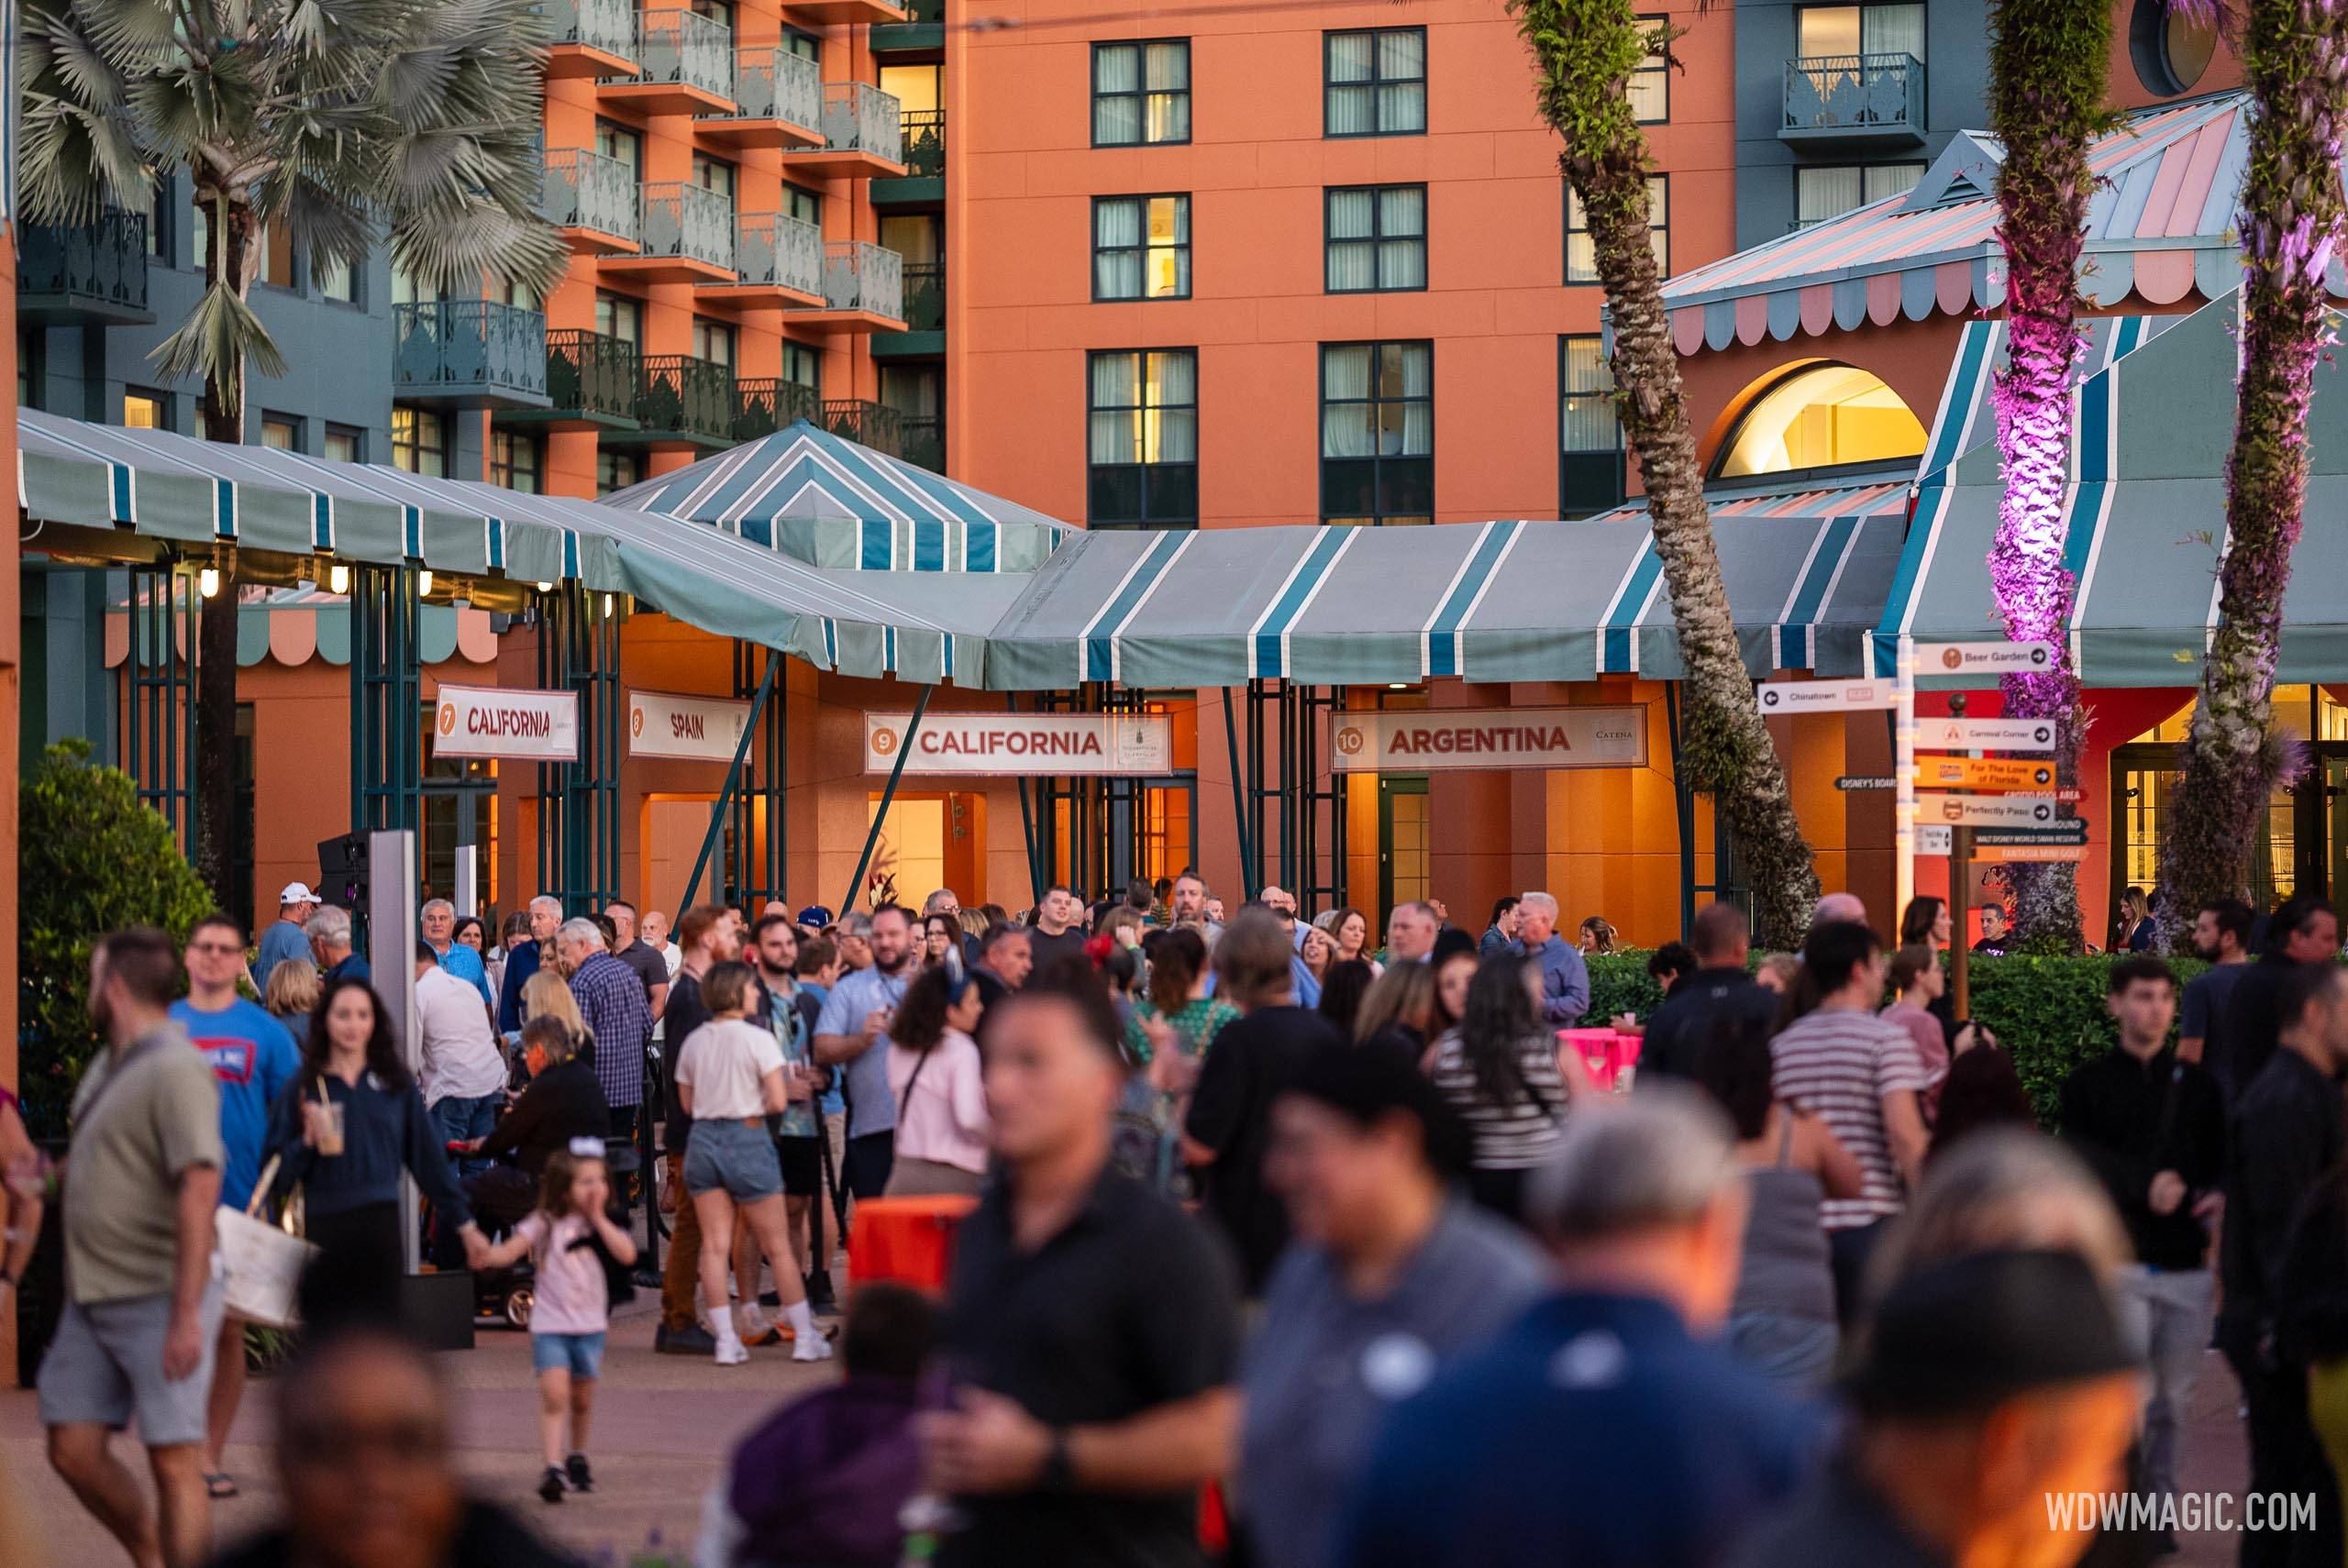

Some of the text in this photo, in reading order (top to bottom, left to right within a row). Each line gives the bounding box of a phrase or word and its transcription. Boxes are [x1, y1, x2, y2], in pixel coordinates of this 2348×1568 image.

[1965, 652, 2029, 662] Beer Garden
[1789, 692, 1836, 701] Chinatown
[443, 707, 550, 739] 7 CALIFORNIA
[634, 712, 704, 741] 8 SPAIN
[878, 730, 1102, 756] 9 CALIFORNIA
[1340, 725, 1571, 755] 10 ARGENTINA
